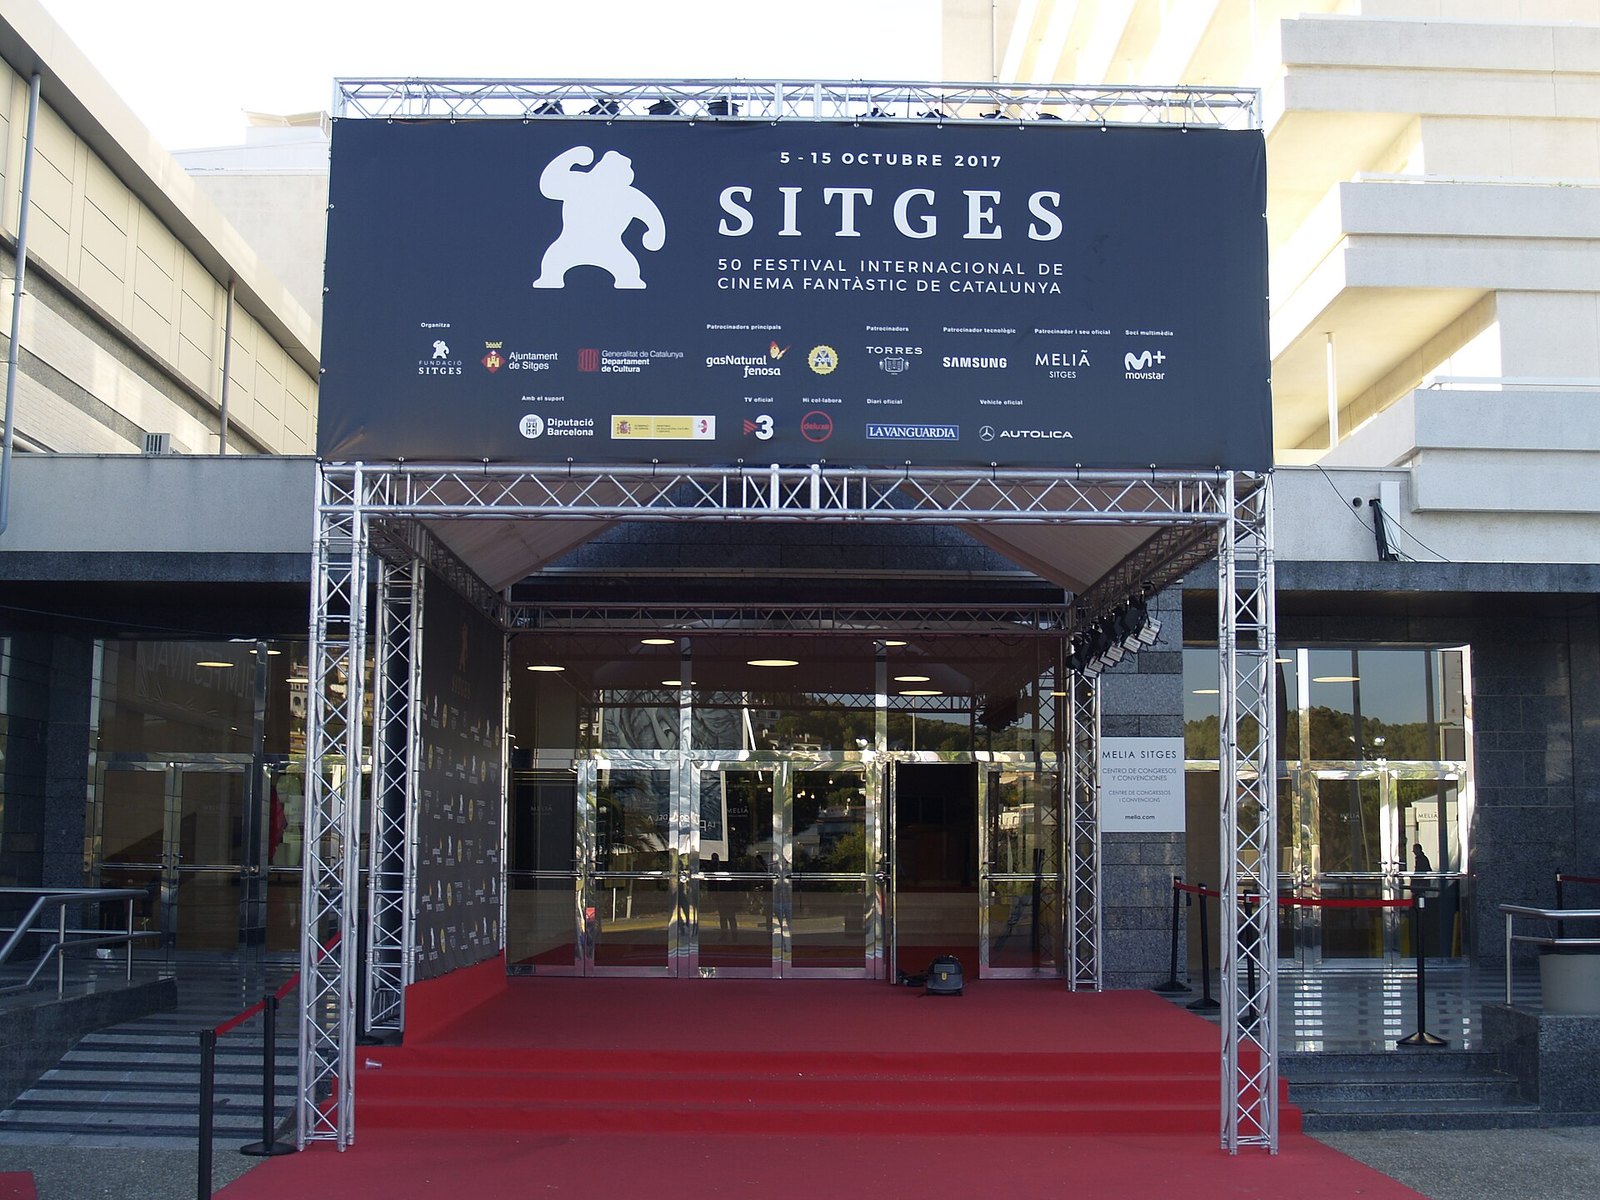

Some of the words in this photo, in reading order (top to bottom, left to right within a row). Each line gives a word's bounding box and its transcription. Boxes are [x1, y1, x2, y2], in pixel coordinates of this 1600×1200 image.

[780, 152, 789, 163] 5
[811, 153, 831, 163] 15
[842, 153, 942, 166] OCTUBRE
[955, 155, 1000, 167] 2017
[719, 186, 1062, 240] SITGES
[718, 259, 741, 270] 50
[754, 259, 846, 271] FESTIVAL
[861, 260, 1024, 274] INTERNACIONAL
[1039, 264, 1062, 275] DE
[718, 278, 793, 289] CINEMA
[804, 276, 906, 291] FANTÀSTIC
[917, 280, 940, 291] DE
[950, 281, 1061, 294] CATALUNYA
[509, 352, 557, 361] Ajuntament
[650, 351, 683, 359] Catalunya
[522, 361, 549, 371] Sitges
[602, 358, 649, 367] Departament
[706, 355, 767, 368] gasNatural
[943, 357, 1007, 368] SAMSUNG
[744, 366, 781, 378] fenosa
[548, 418, 593, 427] Diputació
